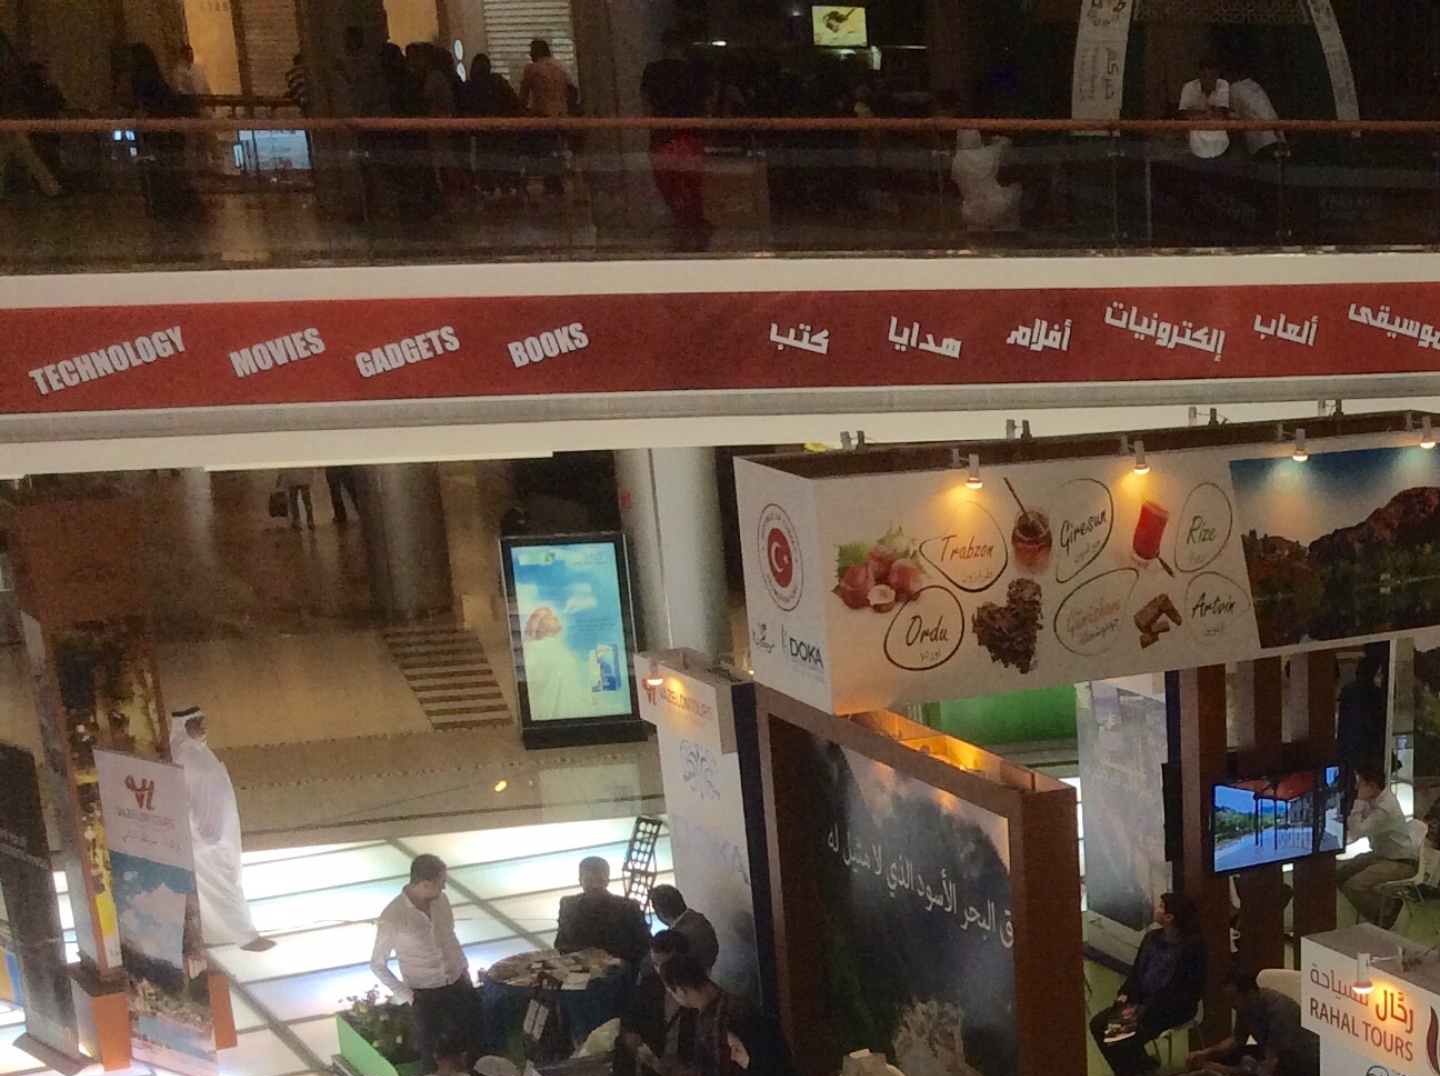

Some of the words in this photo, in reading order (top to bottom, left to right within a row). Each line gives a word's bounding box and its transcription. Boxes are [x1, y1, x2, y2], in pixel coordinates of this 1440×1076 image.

[769, 322, 830, 354] كتب
[888, 315, 962, 359] هدايا
[1006, 318, 1072, 352] أفلام
[1104, 300, 1226, 362] إلكترونيات
[1253, 313, 1319, 347] ألعاب
[29, 325, 187, 396] TECHNOLOGY
[229, 326, 326, 378] MOVIES
[354, 325, 461, 378] GADGETS
[507, 322, 590, 369] BOOKS
[1185, 515, 1218, 545] Rize
[939, 535, 995, 562] Trabzon
[1191, 592, 1235, 619] Artvin
[905, 614, 949, 647] Ordu
[789, 637, 824, 668] DOKA
[887, 855, 915, 898] الذي
[917, 868, 958, 914] الأسود
[960, 899, 997, 941] البحر
[1310, 997, 1359, 1038] RAHAL
[1362, 1020, 1414, 1062] TOURS
